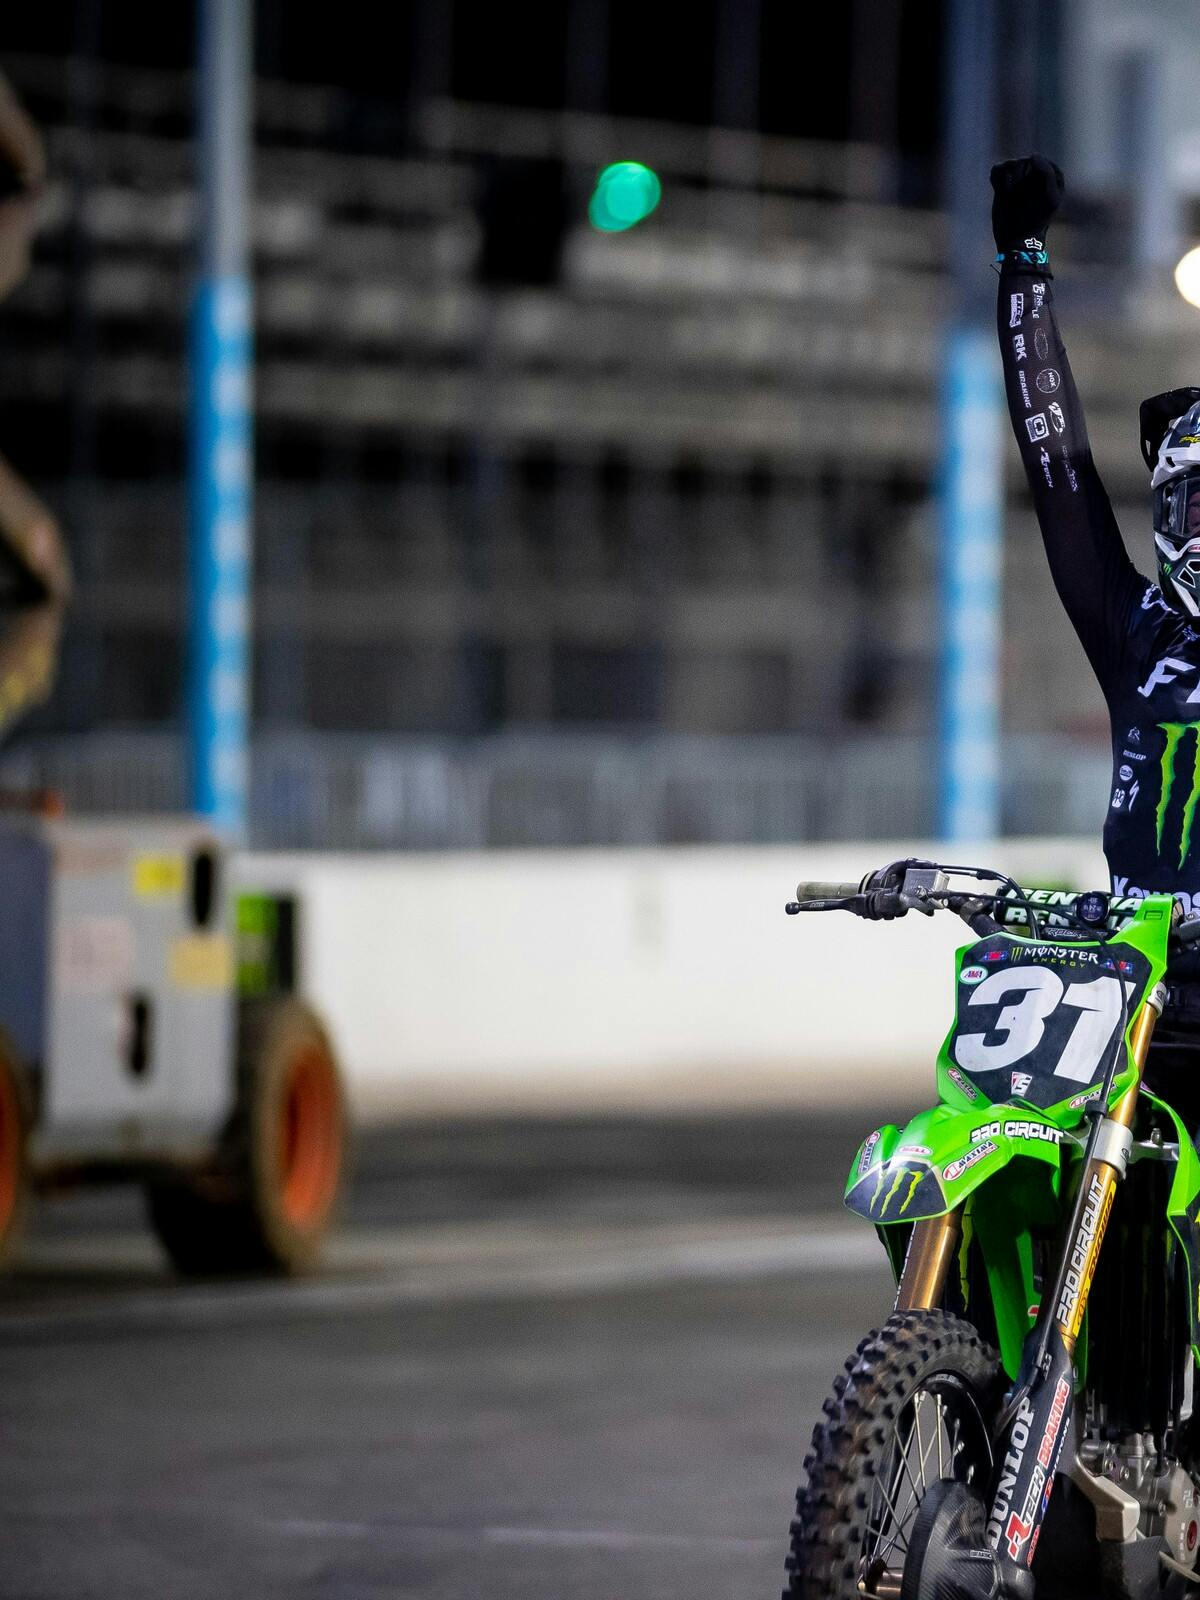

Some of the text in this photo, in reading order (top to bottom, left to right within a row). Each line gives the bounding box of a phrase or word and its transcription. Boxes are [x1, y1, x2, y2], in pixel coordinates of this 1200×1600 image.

[1015, 333, 1027, 361] RK
[1018, 370, 1032, 409] BRAKING
[1032, 957, 1087, 968] ENERGY
[955, 966, 1137, 1084] 31
[971, 1120, 1065, 1145] PRO CIRCUIT
[958, 1140, 994, 1169] MAXIMA
[1056, 1268, 1081, 1328] PRO
[1070, 1174, 1104, 1272] CIRCUIT
[1038, 1378, 1070, 1468] BRAKING
[986, 1397, 1035, 1550] DUNLOP
